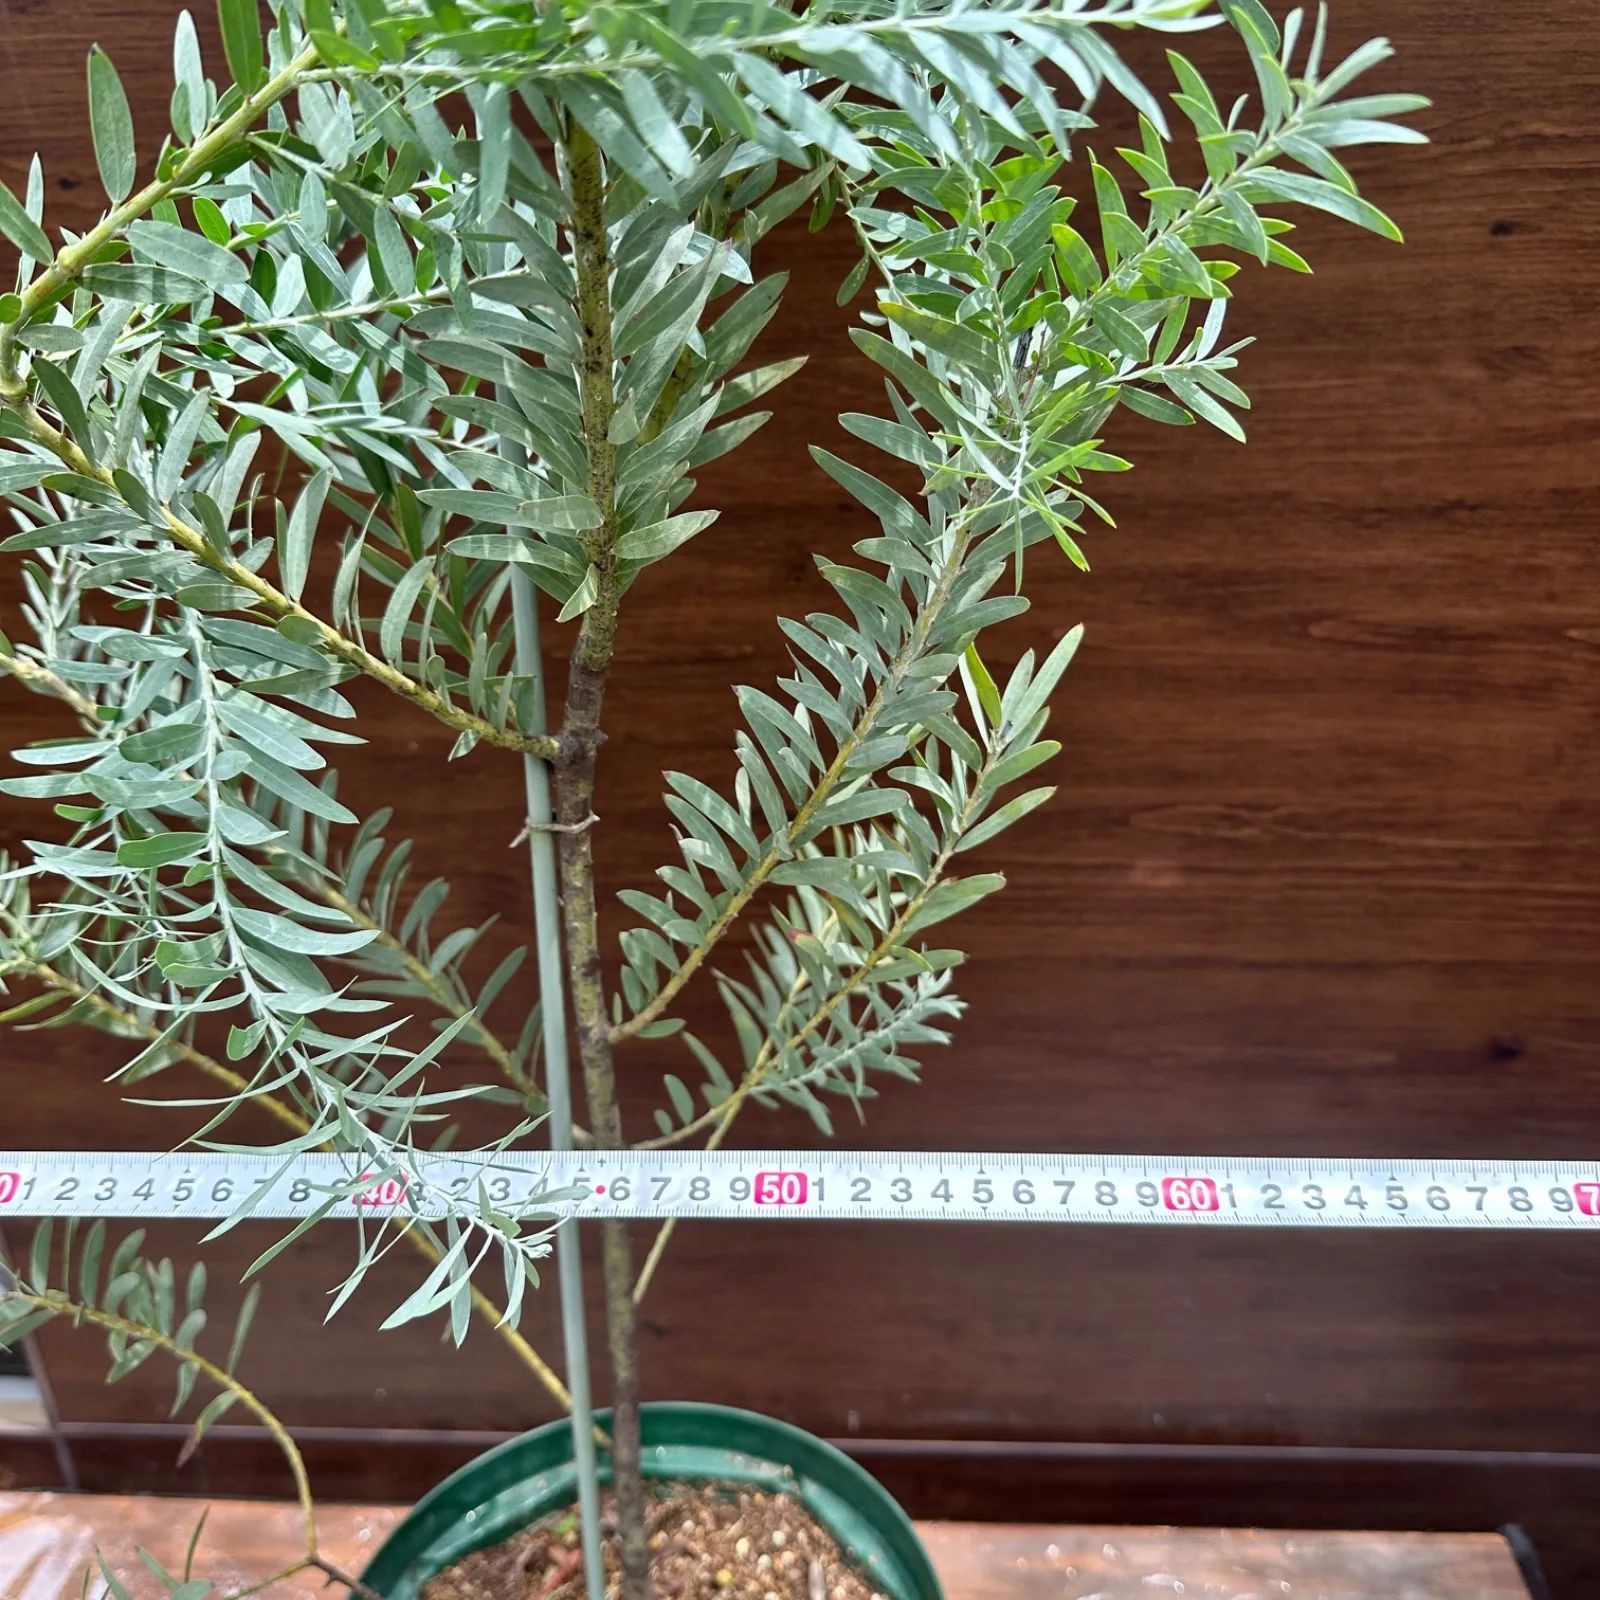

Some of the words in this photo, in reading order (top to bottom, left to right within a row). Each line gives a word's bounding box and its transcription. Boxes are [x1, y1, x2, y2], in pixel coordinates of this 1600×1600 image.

[0, 1174, 14, 1204] 0
[24, 1177, 37, 1200] 1
[54, 1177, 80, 1201] 2
[94, 1177, 118, 1201] 3
[133, 1177, 155, 1201] 4
[172, 1178, 196, 1202] 5
[211, 1178, 234, 1202] 6
[289, 1178, 312, 1202] 8
[489, 1177, 511, 1201] 3
[609, 1176, 631, 1201] 6
[651, 1177, 672, 1201] 7
[688, 1176, 711, 1202] 8
[729, 1176, 750, 1202] 9
[761, 1174, 801, 1204] 50
[812, 1177, 825, 1201] 1
[850, 1177, 872, 1202] 2
[890, 1177, 913, 1203] 3
[930, 1178, 954, 1203] 4
[972, 1179, 994, 1204] 5
[1012, 1179, 1036, 1205] 6
[1053, 1180, 1075, 1205] 7
[1094, 1180, 1119, 1206] 8
[1135, 1181, 1160, 1207] 9
[1169, 1180, 1212, 1210] 60
[1220, 1183, 1237, 1208] 1
[1260, 1183, 1286, 1209] 2
[1302, 1184, 1327, 1210] 3
[1344, 1185, 1369, 1210] 4
[1386, 1186, 1409, 1210] 5
[1426, 1185, 1451, 1211] 6
[1465, 1186, 1488, 1211] 7
[1507, 1186, 1534, 1212] 8
[1548, 1187, 1574, 1213] 9
[1580, 1185, 1600, 1215] 7
